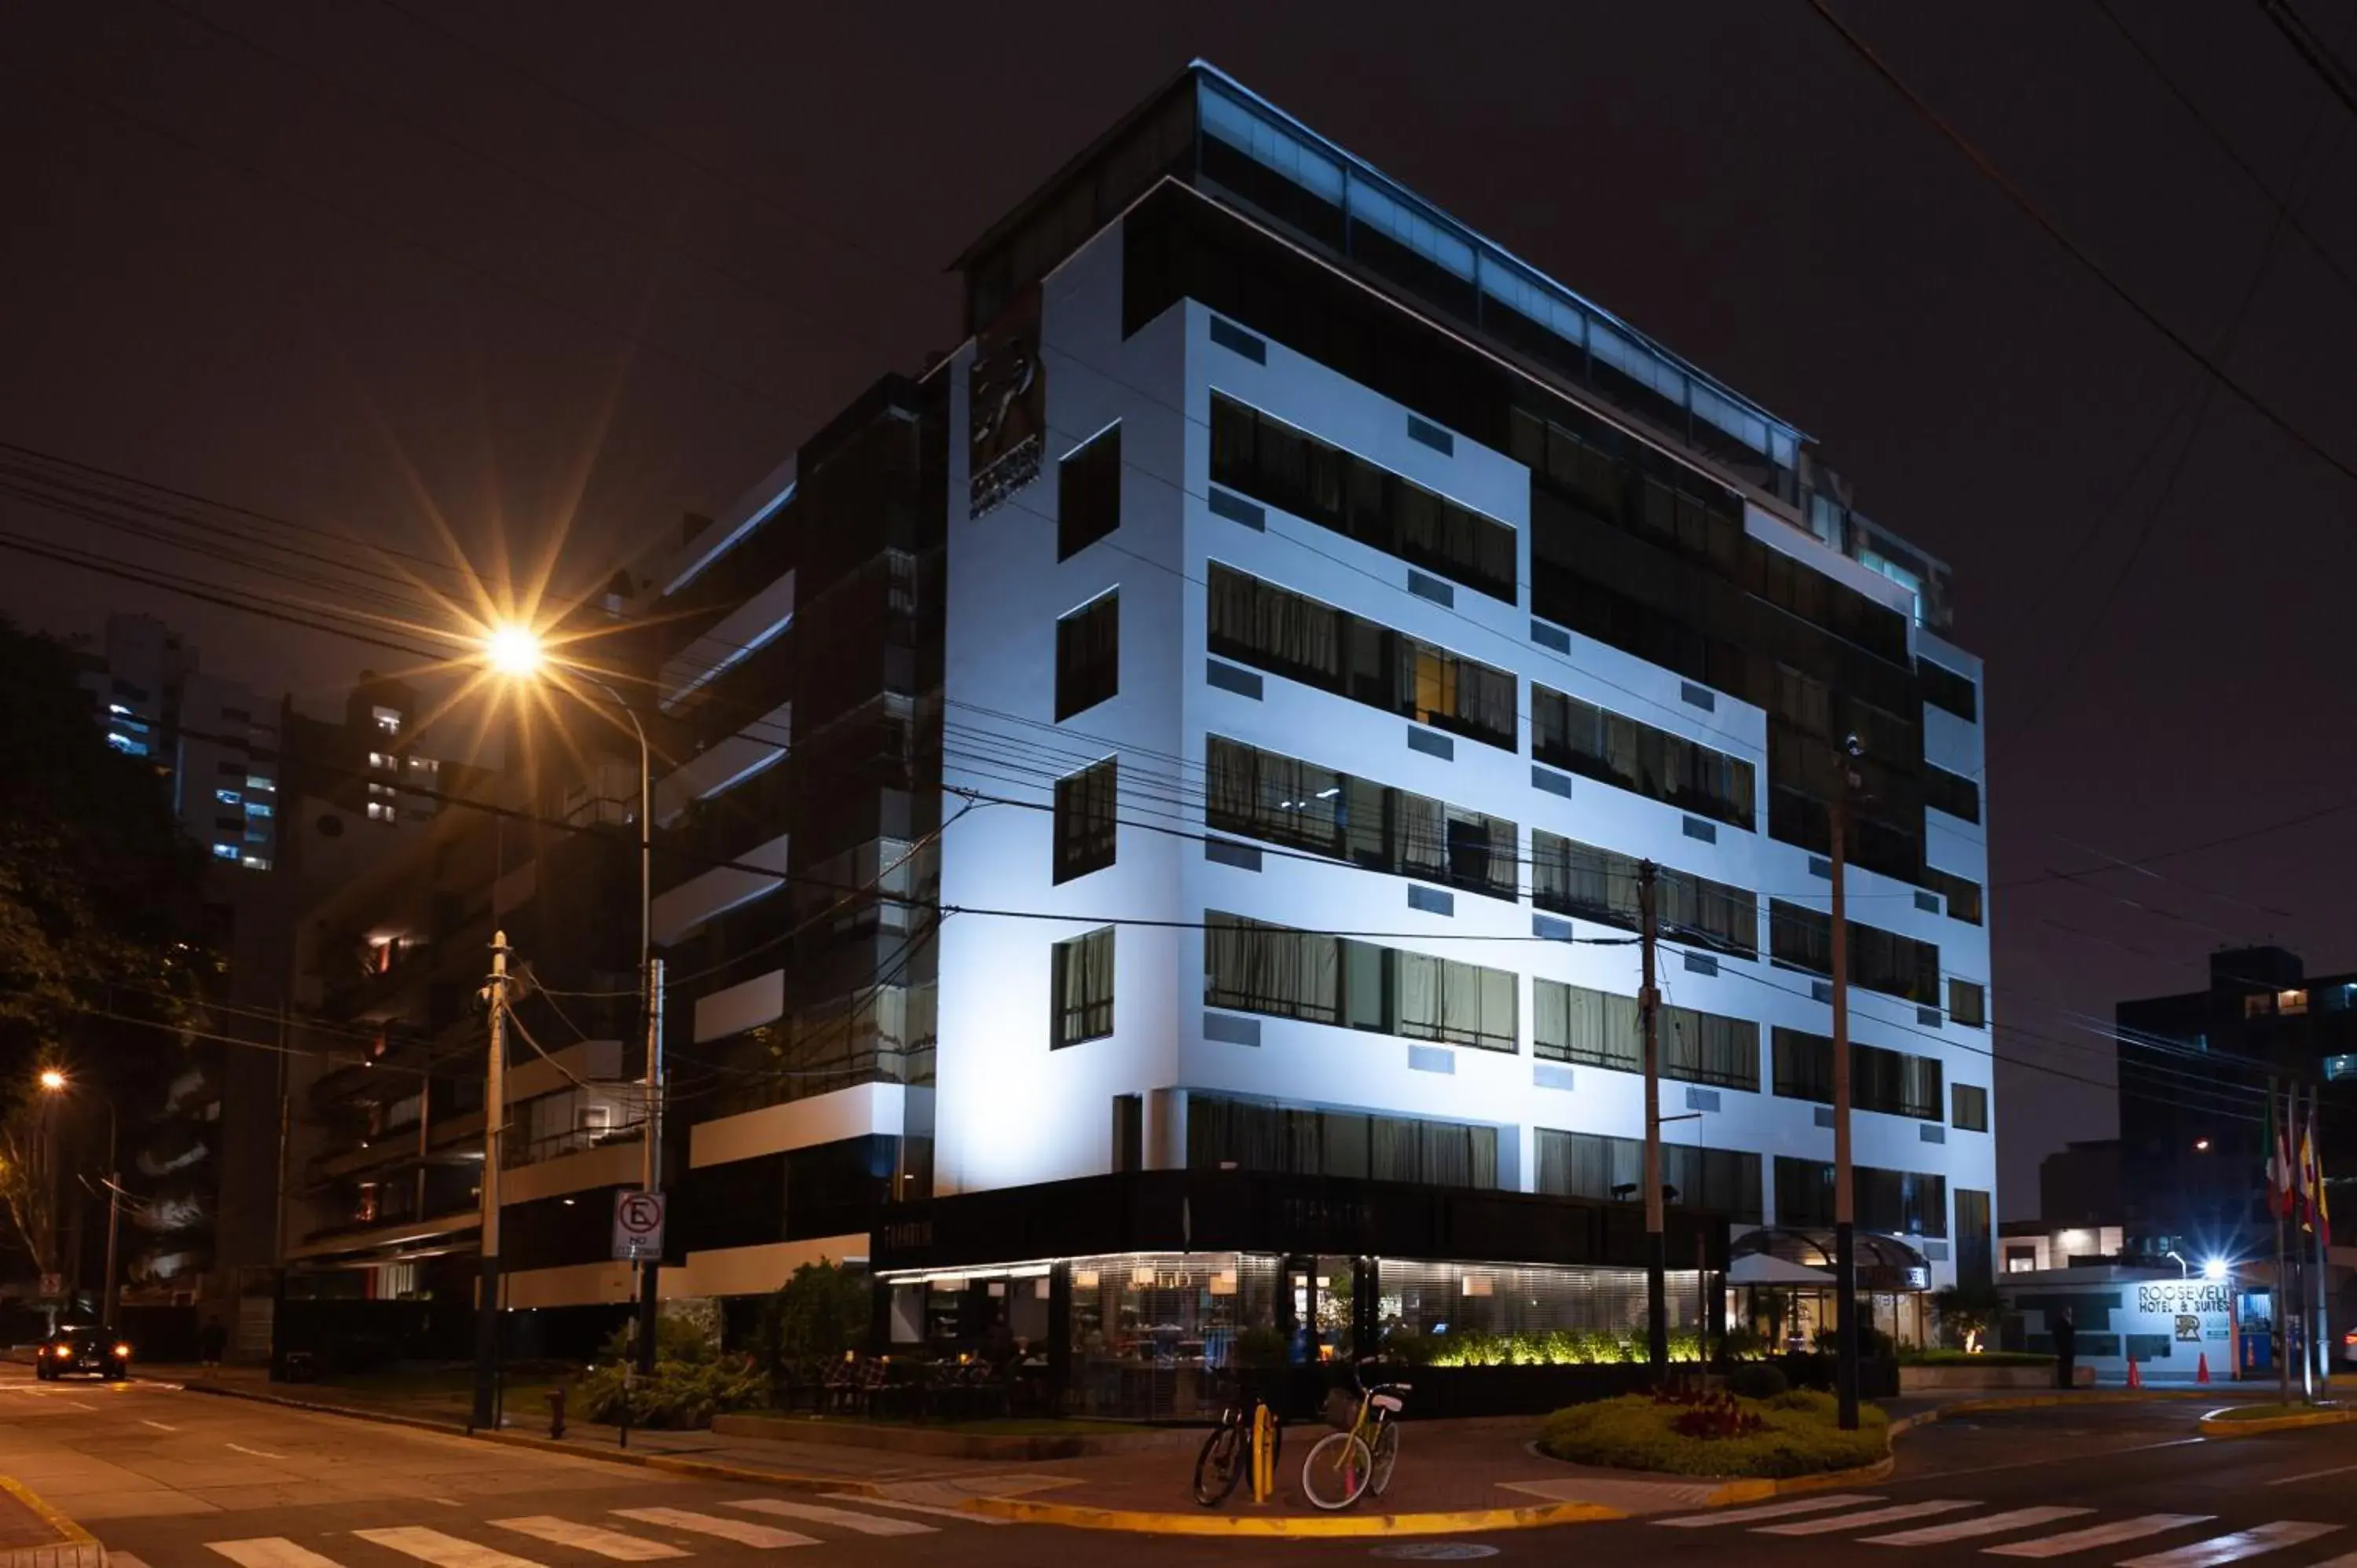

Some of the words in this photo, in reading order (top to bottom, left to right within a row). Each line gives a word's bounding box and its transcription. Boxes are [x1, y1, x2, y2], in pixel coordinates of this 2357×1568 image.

[2139, 1285, 2229, 1300] ROOSEVELT
[2139, 1301, 2172, 1313] HOTEL
[2180, 1300, 2188, 1313] &
[2194, 1300, 2231, 1312] SUITES
